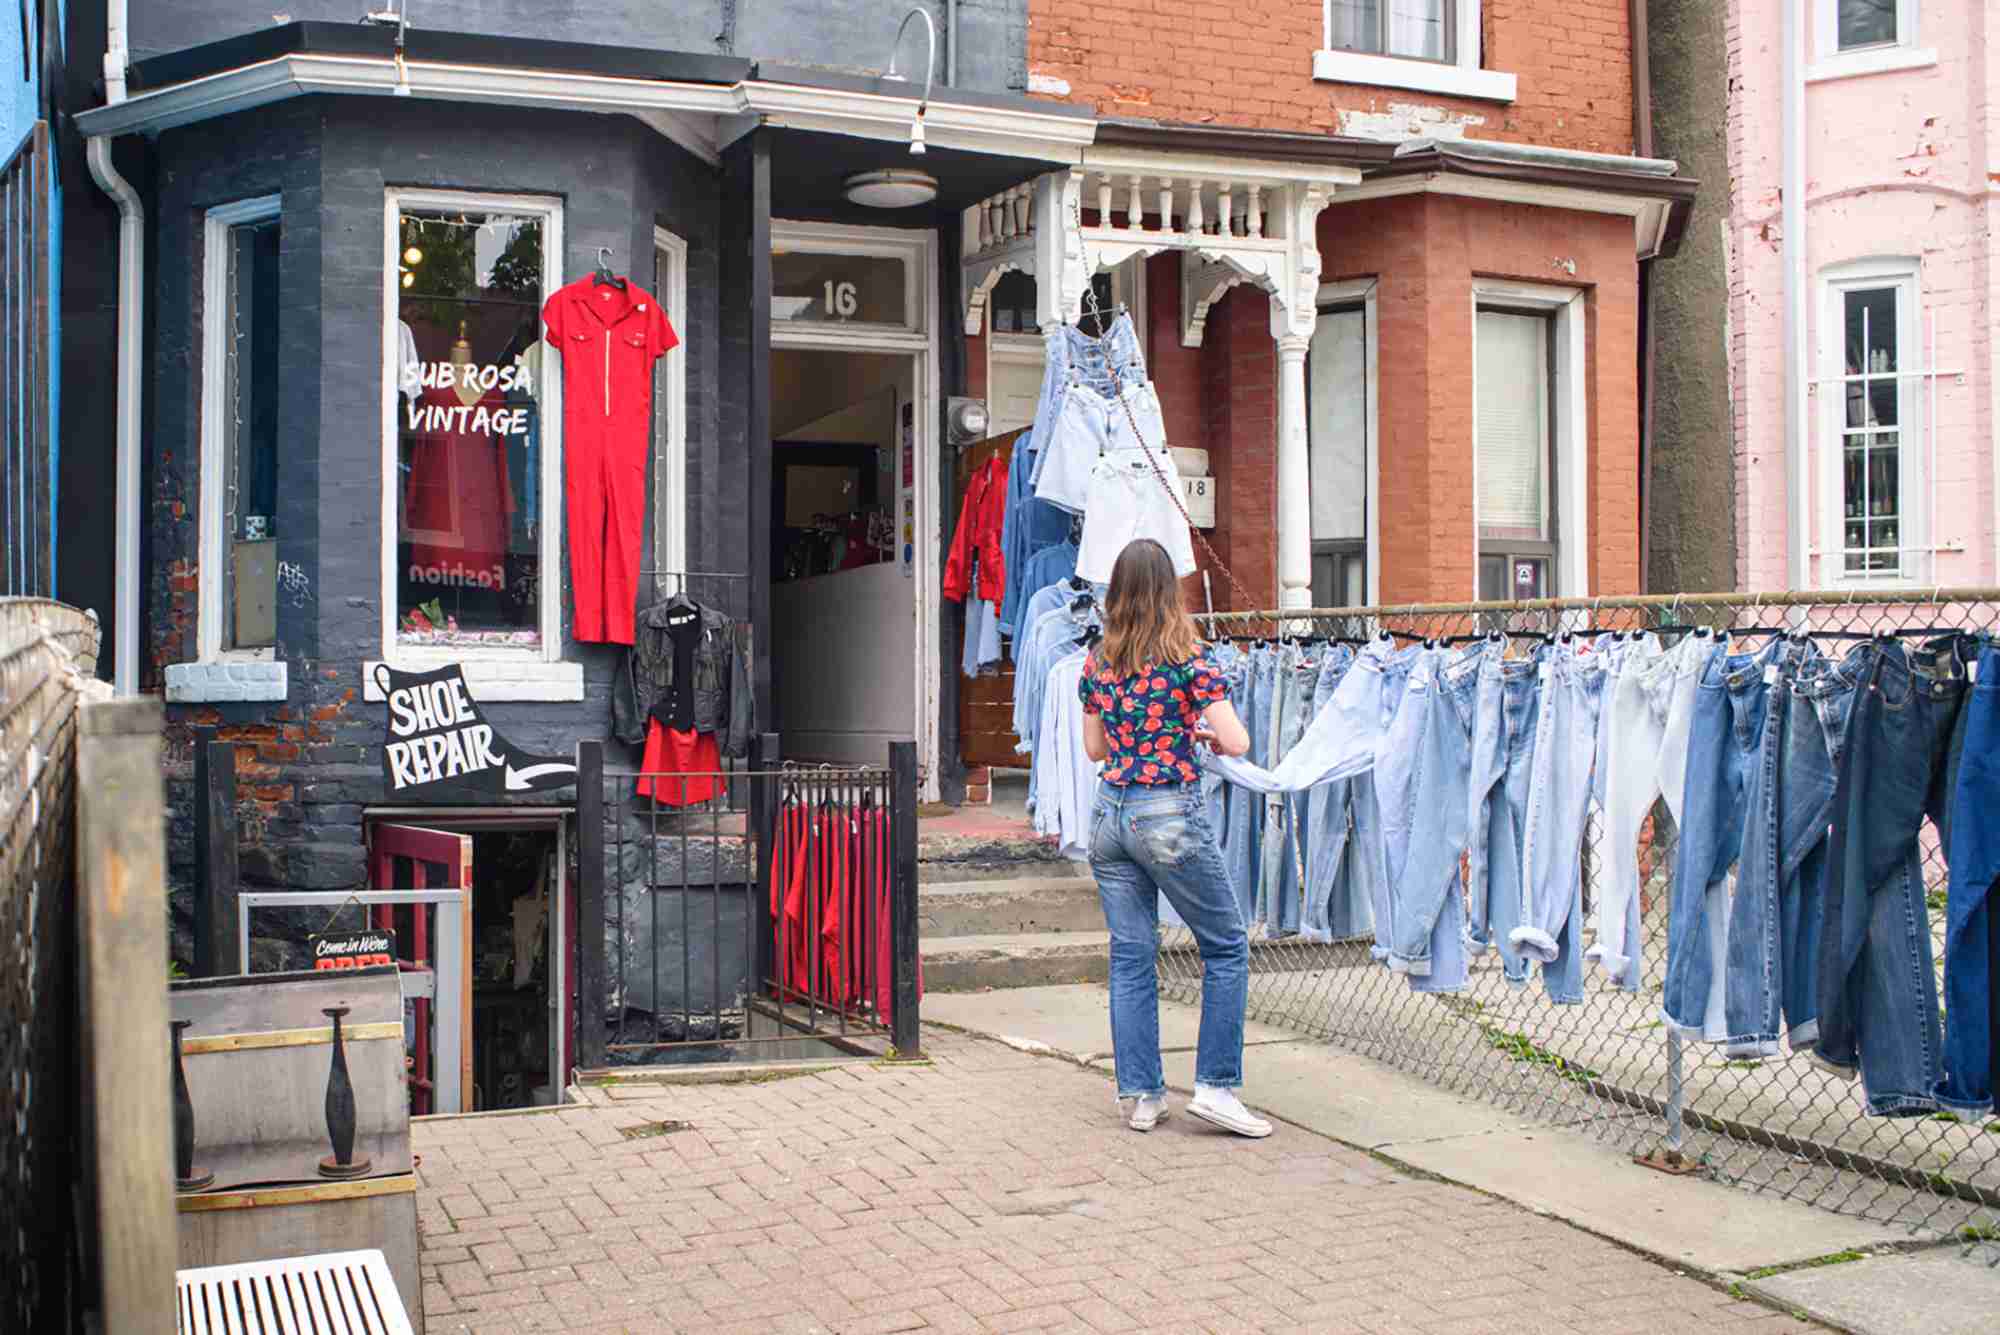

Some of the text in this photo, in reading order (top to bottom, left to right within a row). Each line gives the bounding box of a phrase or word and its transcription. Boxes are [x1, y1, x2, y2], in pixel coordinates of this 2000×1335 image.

[824, 280, 857, 316] 16
[404, 361, 532, 396] SUB ROSA
[408, 404, 528, 437] VINTAGE
[1188, 480, 1205, 496] 18
[389, 677, 476, 736] SHOE
[385, 724, 505, 790] REPAIR
[316, 940, 347, 957] Come
